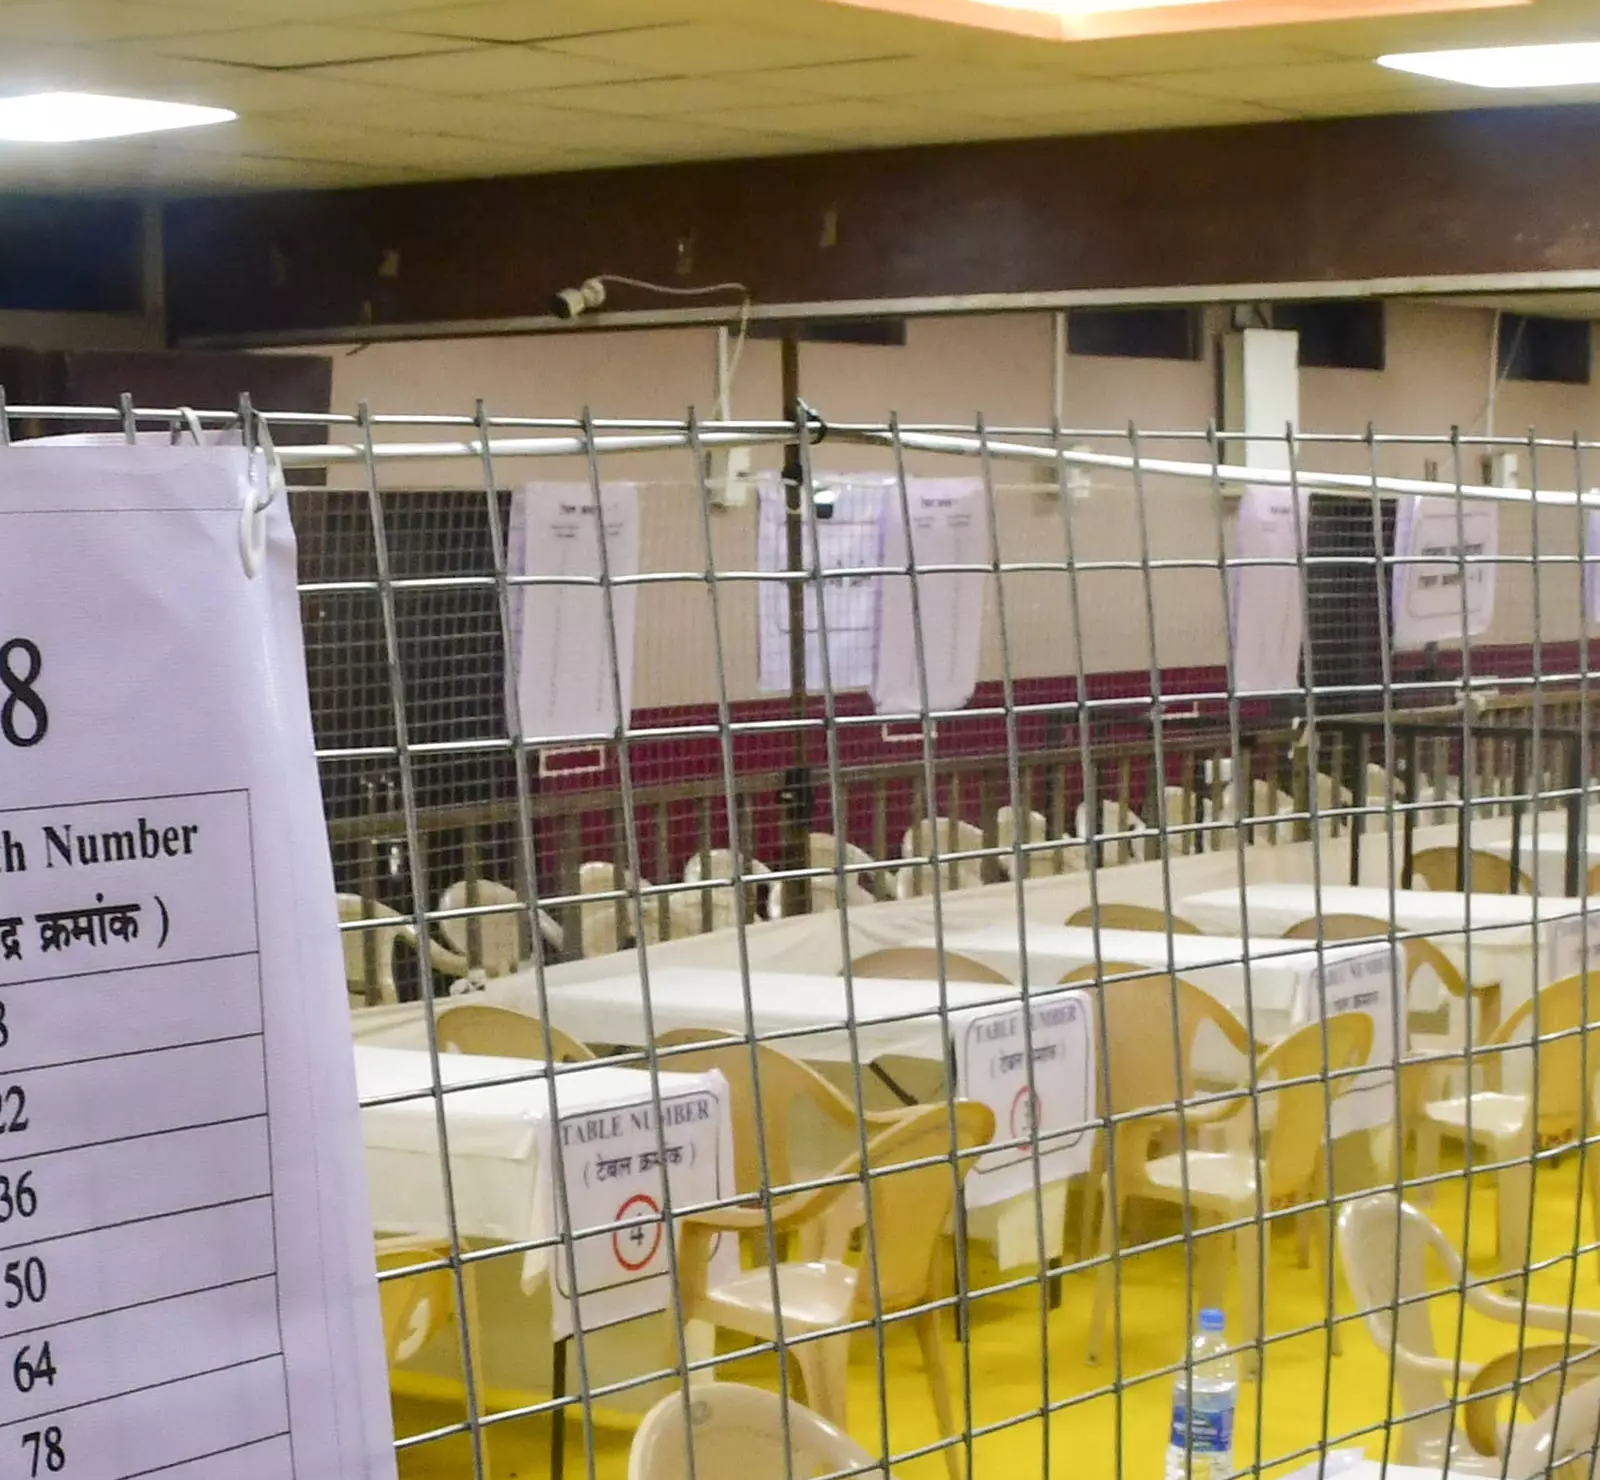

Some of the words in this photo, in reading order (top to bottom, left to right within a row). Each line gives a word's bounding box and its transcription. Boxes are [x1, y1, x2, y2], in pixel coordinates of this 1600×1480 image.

[42, 818, 198, 868] Number
[34, 893, 141, 952] क्रमांक
[561, 1111, 625, 1146] TABLE
[4, 1256, 46, 1308] 50
[14, 1341, 57, 1393] 64
[22, 1426, 65, 1478] 78
